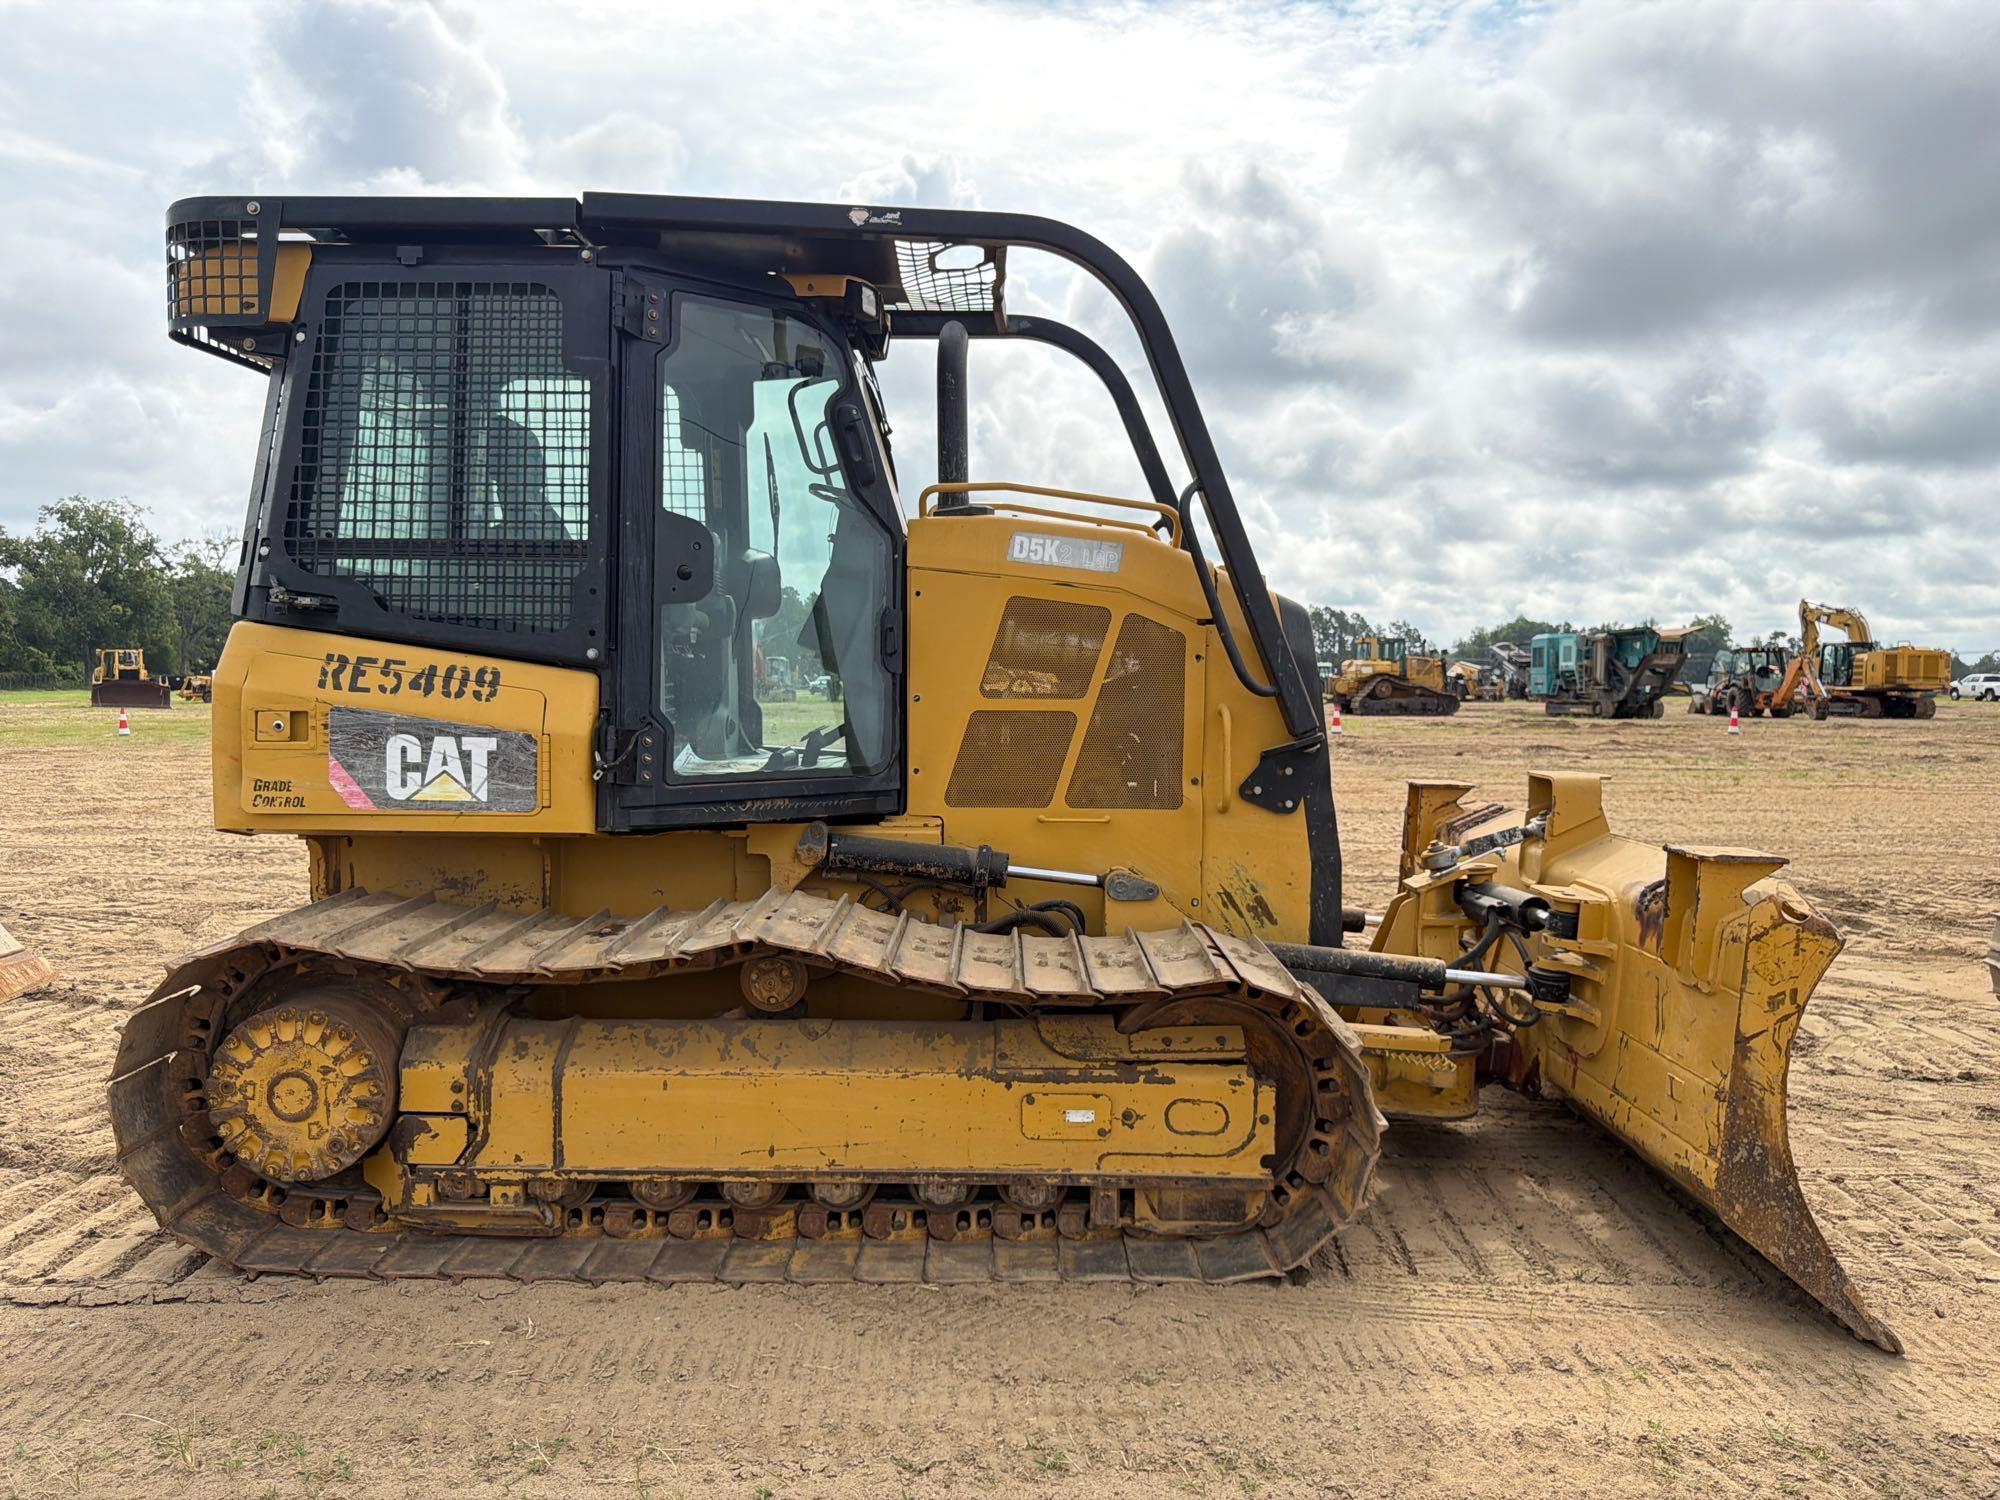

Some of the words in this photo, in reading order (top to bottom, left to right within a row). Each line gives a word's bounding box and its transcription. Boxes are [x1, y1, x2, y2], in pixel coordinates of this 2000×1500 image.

[1013, 535, 1072, 565] D5K2
[317, 652, 501, 703] RE5409
[386, 733, 498, 803] CAT
[252, 793, 306, 808] CONTROL
[253, 778, 293, 793] GRADE
